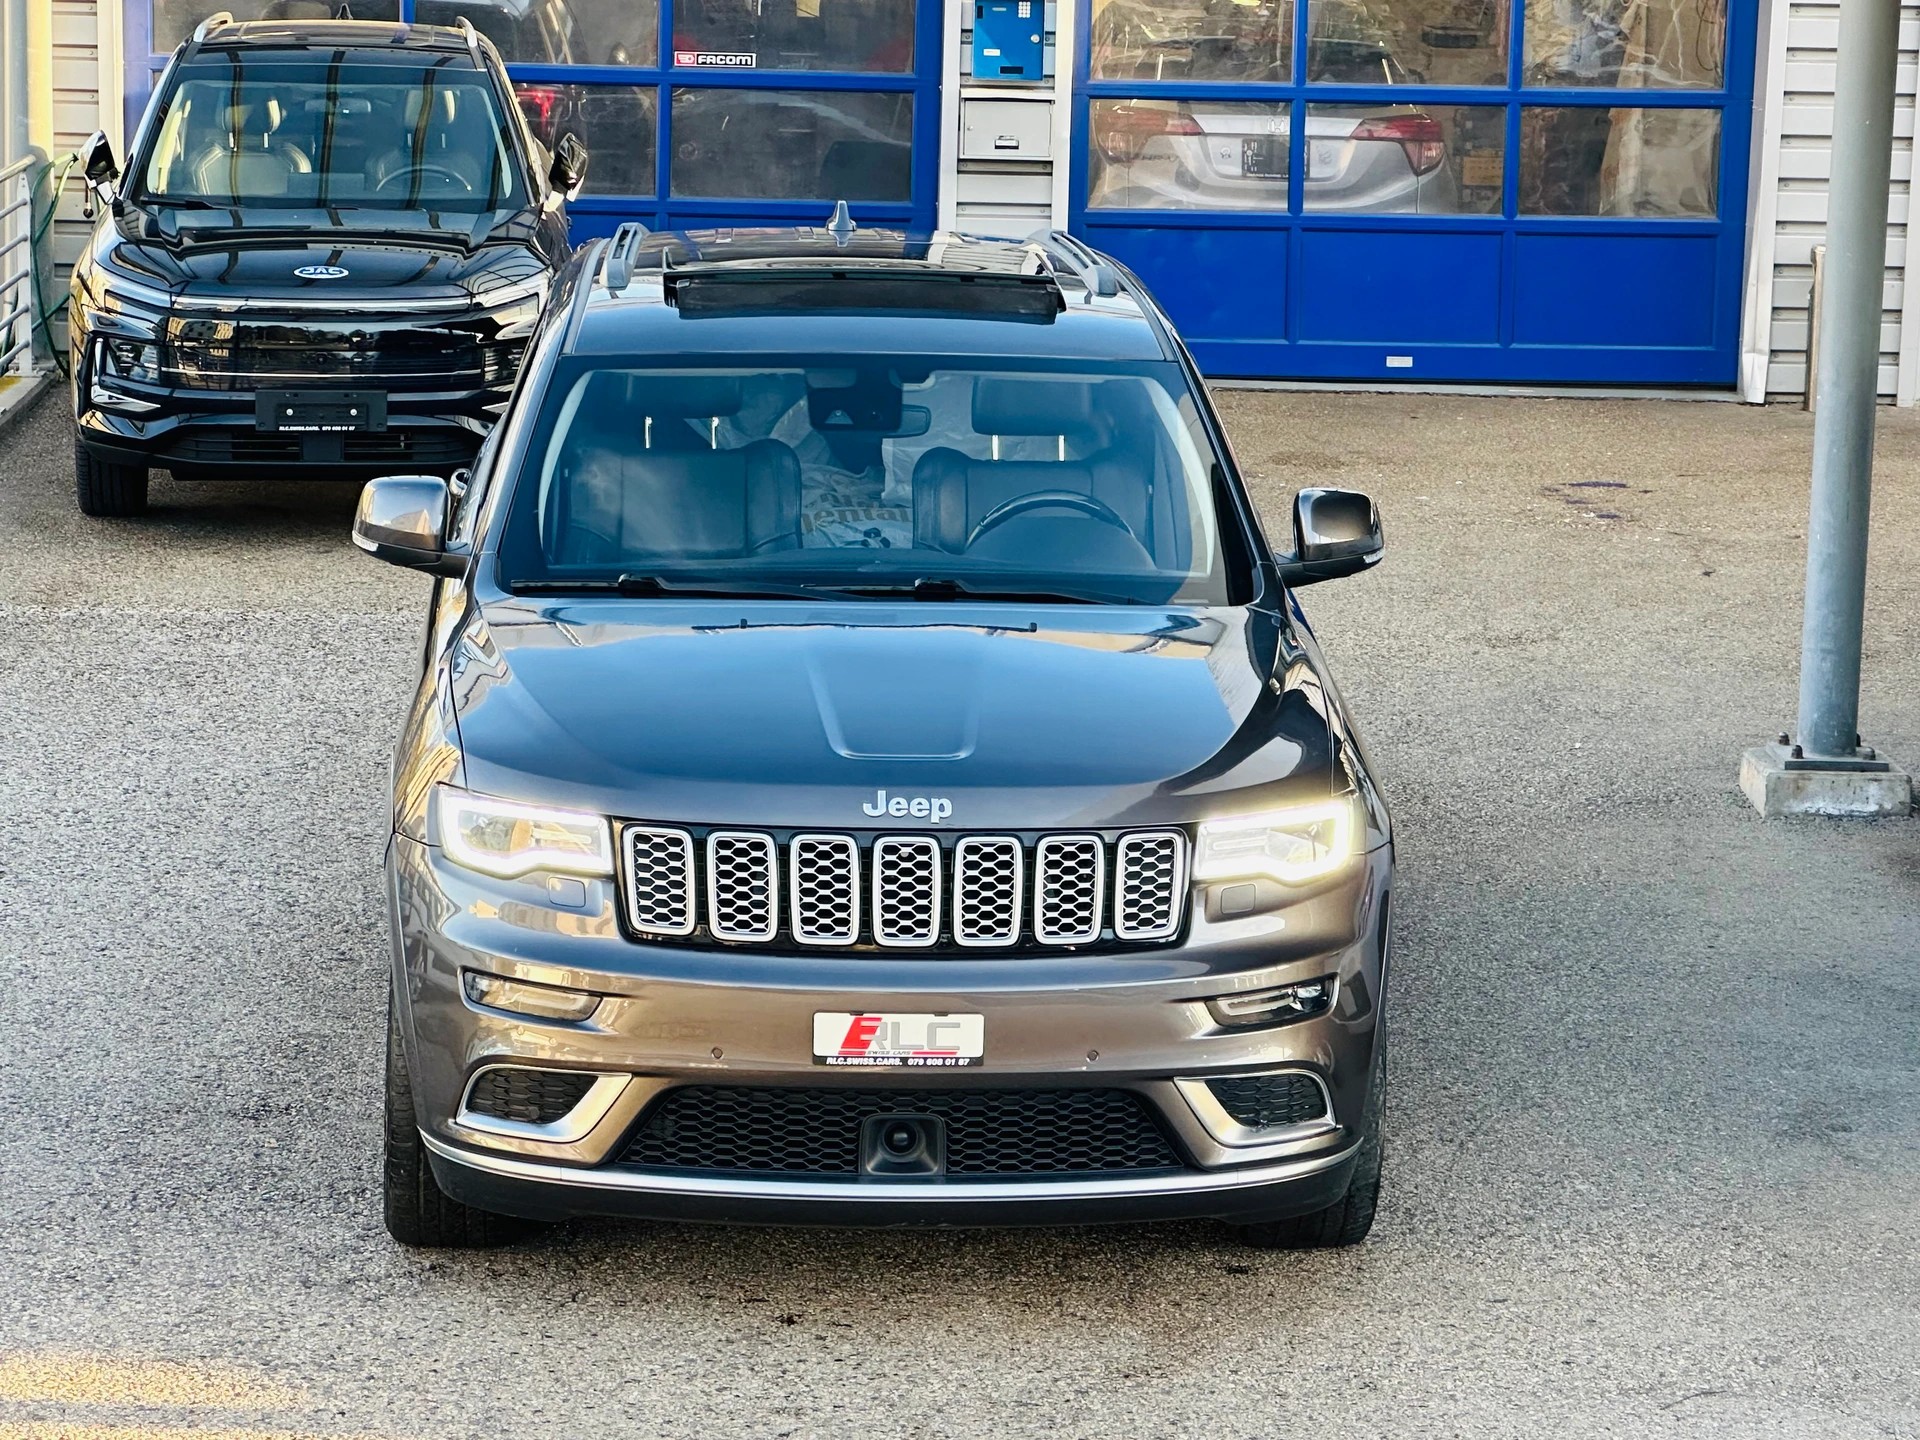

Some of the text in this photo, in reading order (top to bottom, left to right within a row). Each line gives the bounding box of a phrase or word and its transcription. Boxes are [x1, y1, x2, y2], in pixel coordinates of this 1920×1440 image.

[697, 55, 752, 65] FACOM
[862, 789, 953, 824] Jeep
[907, 1058, 924, 1066] 079
[926, 1058, 943, 1066] 608
[945, 1058, 956, 1066] 01
[958, 1058, 970, 1066] 87
